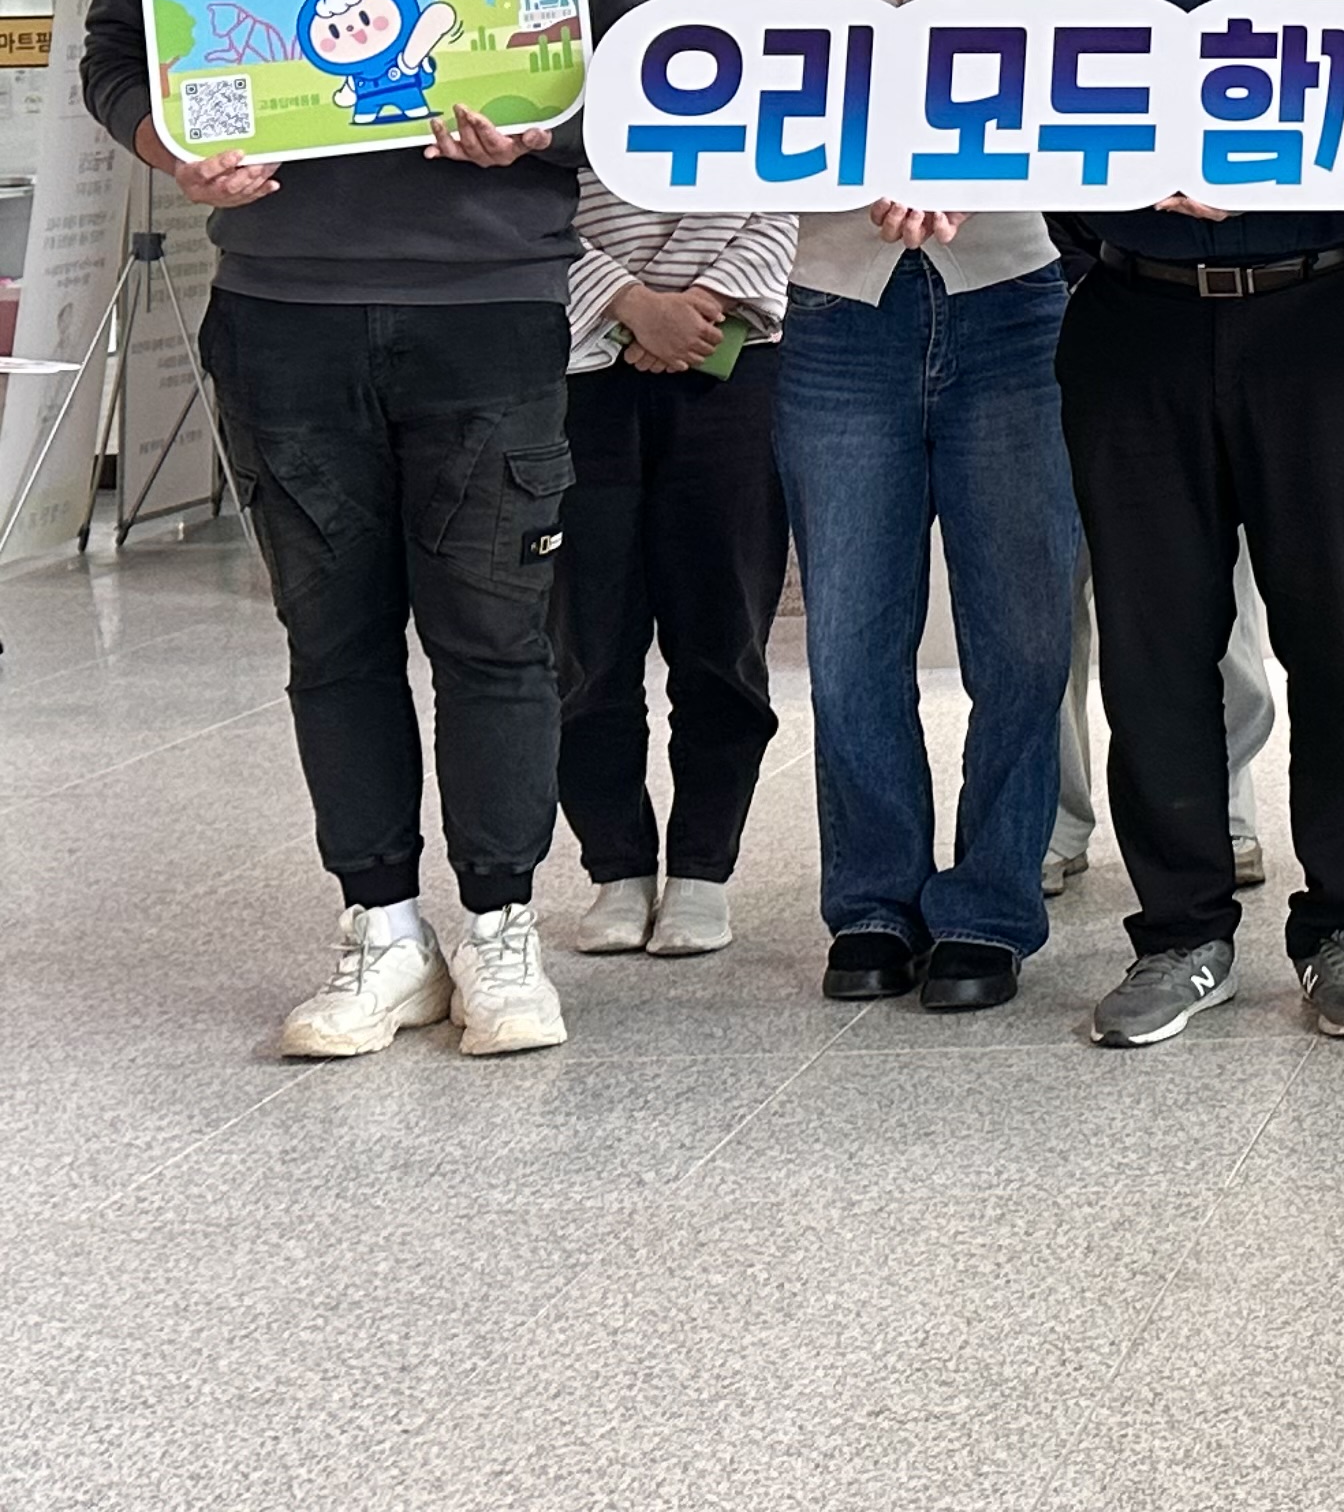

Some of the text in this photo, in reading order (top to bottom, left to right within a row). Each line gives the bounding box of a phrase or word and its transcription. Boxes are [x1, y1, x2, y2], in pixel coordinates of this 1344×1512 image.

[625, 23, 875, 187] 우리
[909, 25, 1158, 186] 모두
[1190, 965, 1216, 997] N
